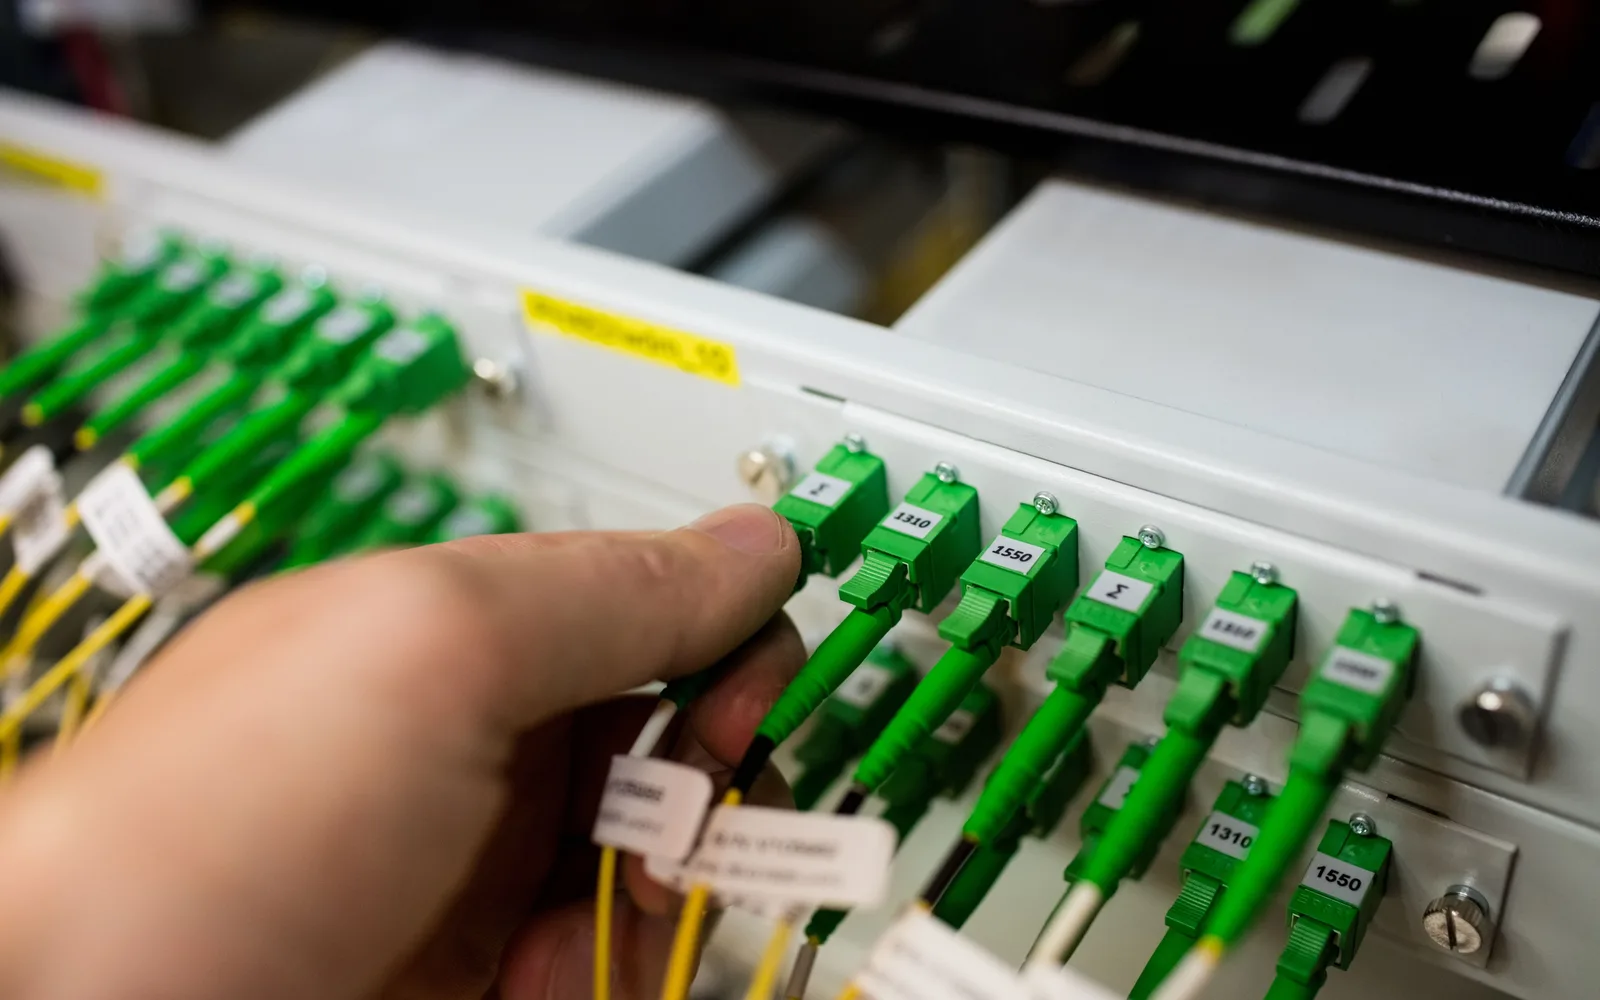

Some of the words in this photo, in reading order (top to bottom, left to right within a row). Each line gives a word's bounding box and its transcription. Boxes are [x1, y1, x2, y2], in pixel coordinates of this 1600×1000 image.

[894, 511, 931, 529] 1310
[992, 545, 1033, 563] 1550
[1211, 823, 1253, 849] 1310
[1316, 865, 1362, 892] 1550
